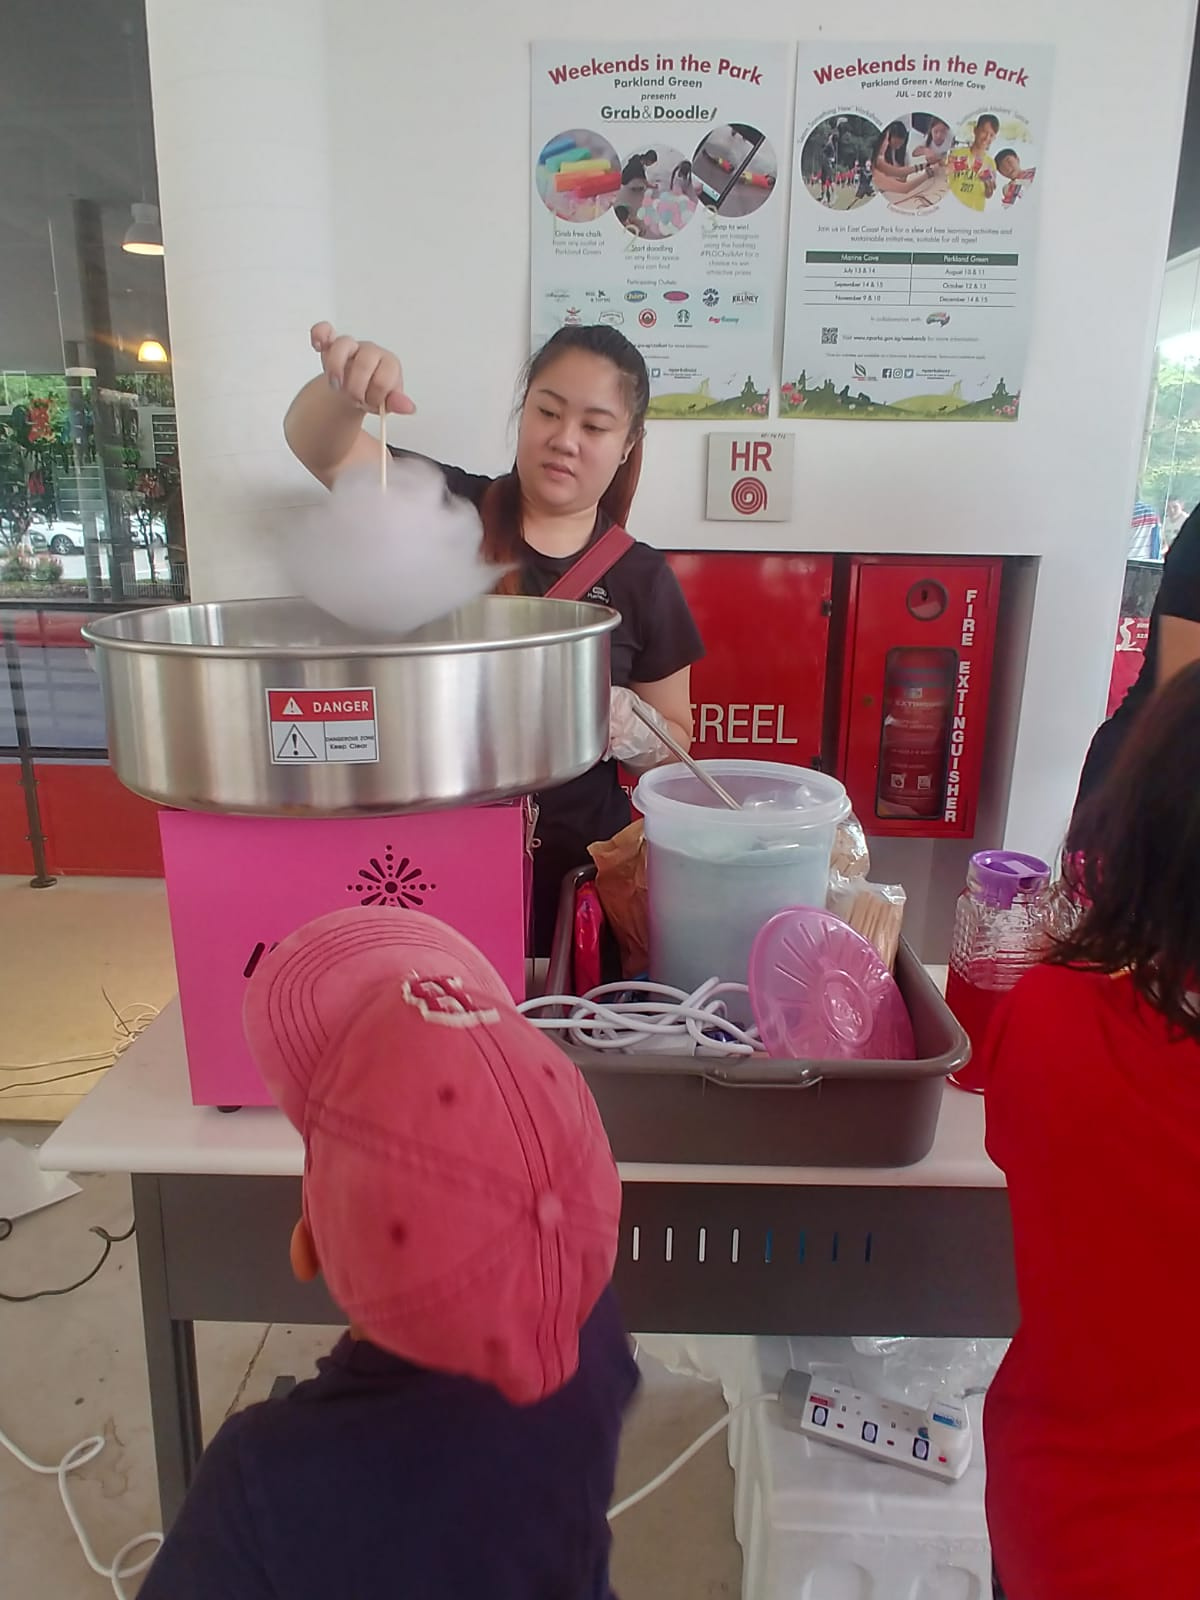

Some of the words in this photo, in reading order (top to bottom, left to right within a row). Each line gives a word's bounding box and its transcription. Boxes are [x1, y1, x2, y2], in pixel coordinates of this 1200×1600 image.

[548, 54, 649, 85] Weekends
[656, 54, 674, 71] in
[681, 54, 711, 73] the
[718, 58, 764, 85] Park
[813, 54, 916, 85] Weekends
[923, 54, 941, 72] in
[947, 55, 978, 75] the
[984, 60, 1029, 87] Park
[614, 76, 665, 88] Parkland
[668, 76, 703, 89] Green
[861, 78, 899, 89] Parkland
[902, 78, 928, 86] Green
[935, 78, 964, 87] Marine
[966, 80, 986, 90] Cove
[641, 92, 677, 102] presents
[896, 90, 909, 98] JUL
[917, 90, 932, 98] DEC
[934, 90, 952, 98] 2019
[572, 230, 584, 238] free
[881, 225, 894, 233] Park
[943, 255, 969, 263] Parkland
[731, 441, 772, 471] HR
[961, 589, 978, 647] FIRE
[313, 700, 369, 713] DANGER
[690, 703, 798, 743] REEL
[944, 661, 971, 823] EXTINGUISHER
